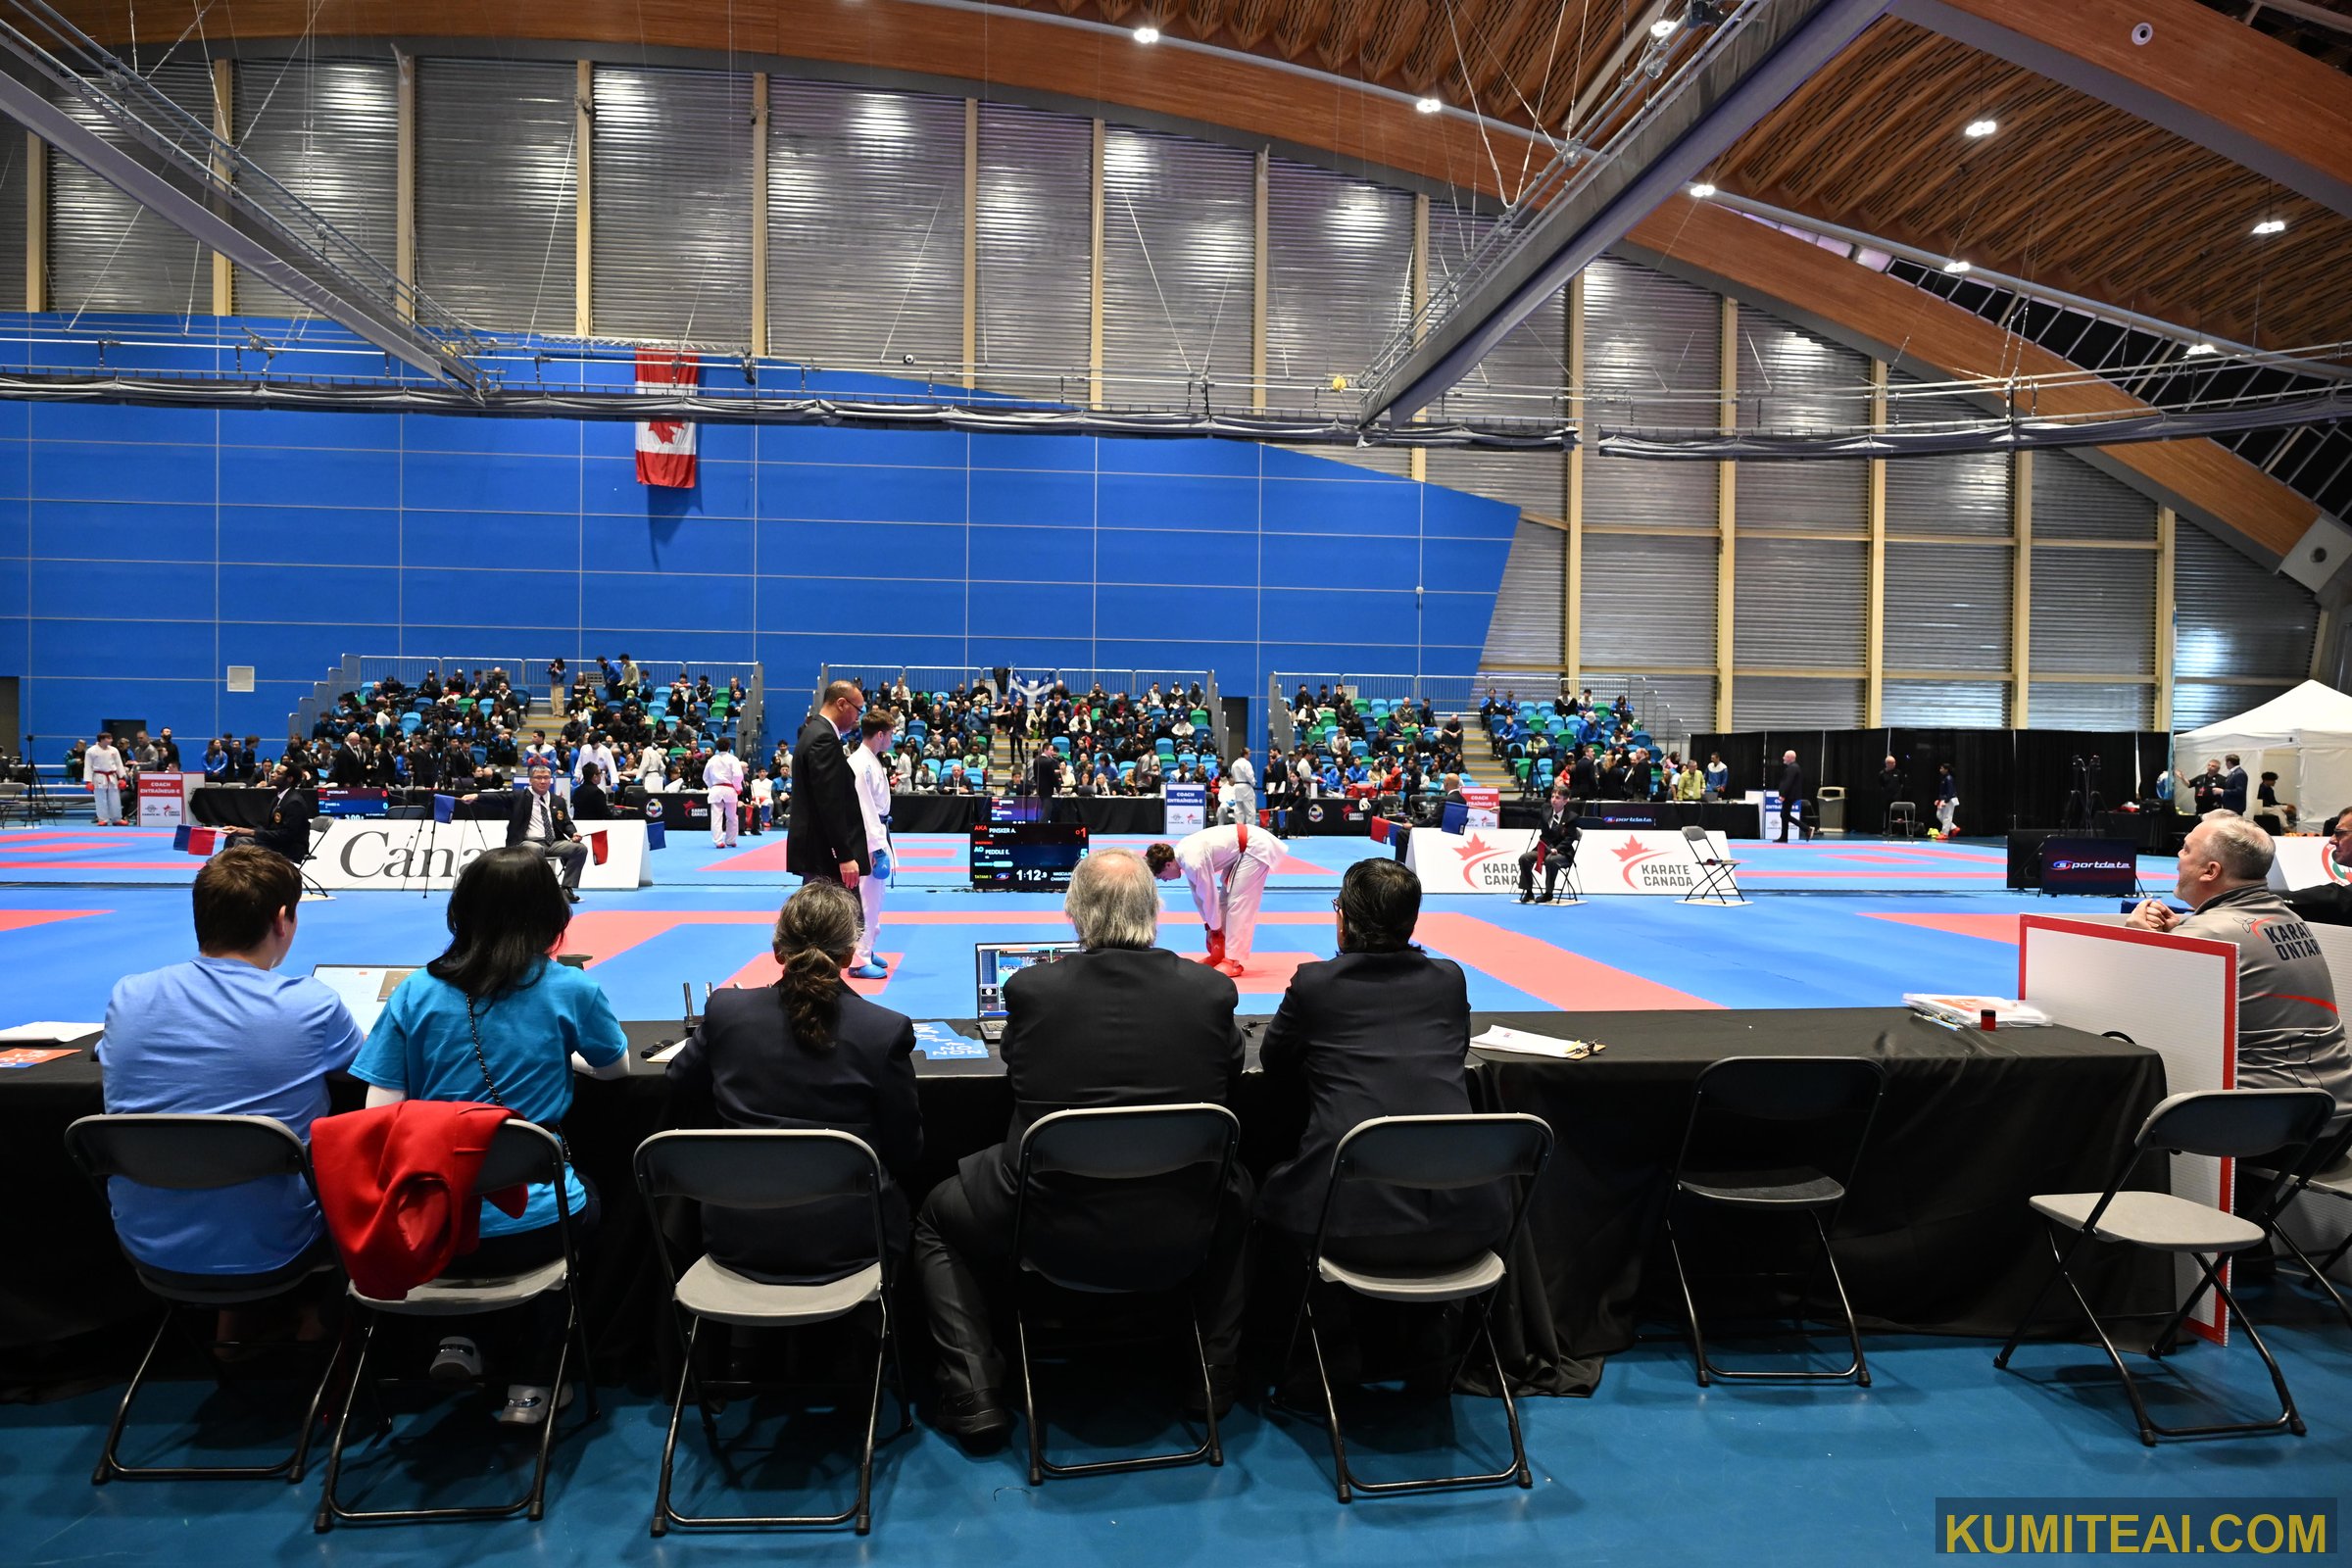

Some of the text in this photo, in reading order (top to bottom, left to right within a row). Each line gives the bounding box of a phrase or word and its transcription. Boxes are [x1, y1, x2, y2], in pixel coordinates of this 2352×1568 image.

[1483, 863, 1519, 873] KARA
[1642, 864, 1690, 875] KARATE
[1485, 875, 1519, 885] CANA
[1643, 876, 1693, 887] CANADA
